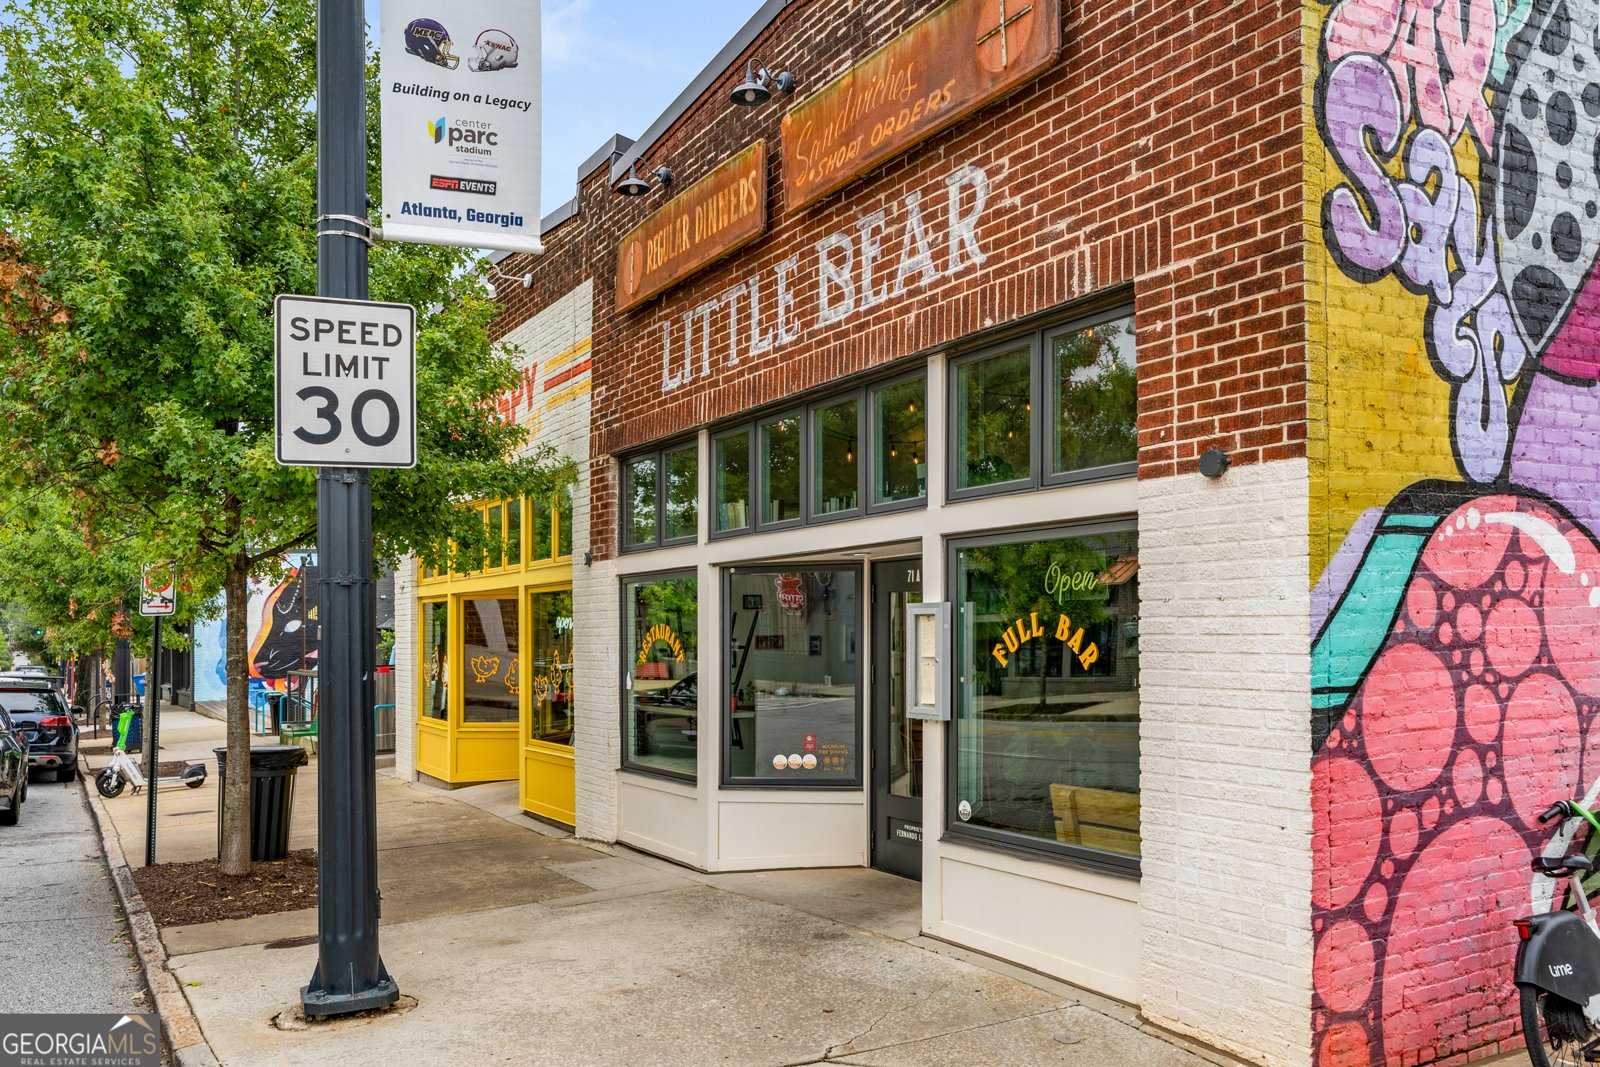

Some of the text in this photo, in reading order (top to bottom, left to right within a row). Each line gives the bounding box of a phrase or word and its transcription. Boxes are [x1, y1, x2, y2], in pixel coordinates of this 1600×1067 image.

[413, 27, 444, 40] MEAC
[392, 82, 532, 112] Building on a Legacy
[455, 119, 492, 129] center
[796, 56, 918, 187] Sandwiches
[815, 79, 956, 182] SHORT ORDERS
[448, 127, 498, 146] parc
[455, 145, 492, 156] stadium
[431, 177, 495, 193] ESPN EVENTS
[401, 201, 523, 228] Atlanta, Georgia
[647, 170, 757, 275] REGULAR DINNERS
[661, 165, 987, 393] LITTLE BEAR
[289, 316, 402, 347] SPEED
[303, 352, 390, 380] LIMIT
[293, 386, 400, 447] 30
[907, 569, 915, 583] 71
[1044, 561, 1099, 605] Open
[638, 623, 686, 664] RESTAURANT
[992, 611, 1100, 670] FULL BAR
[904, 824, 923, 832] PROPRIET
[1548, 963, 1573, 978] Lime
